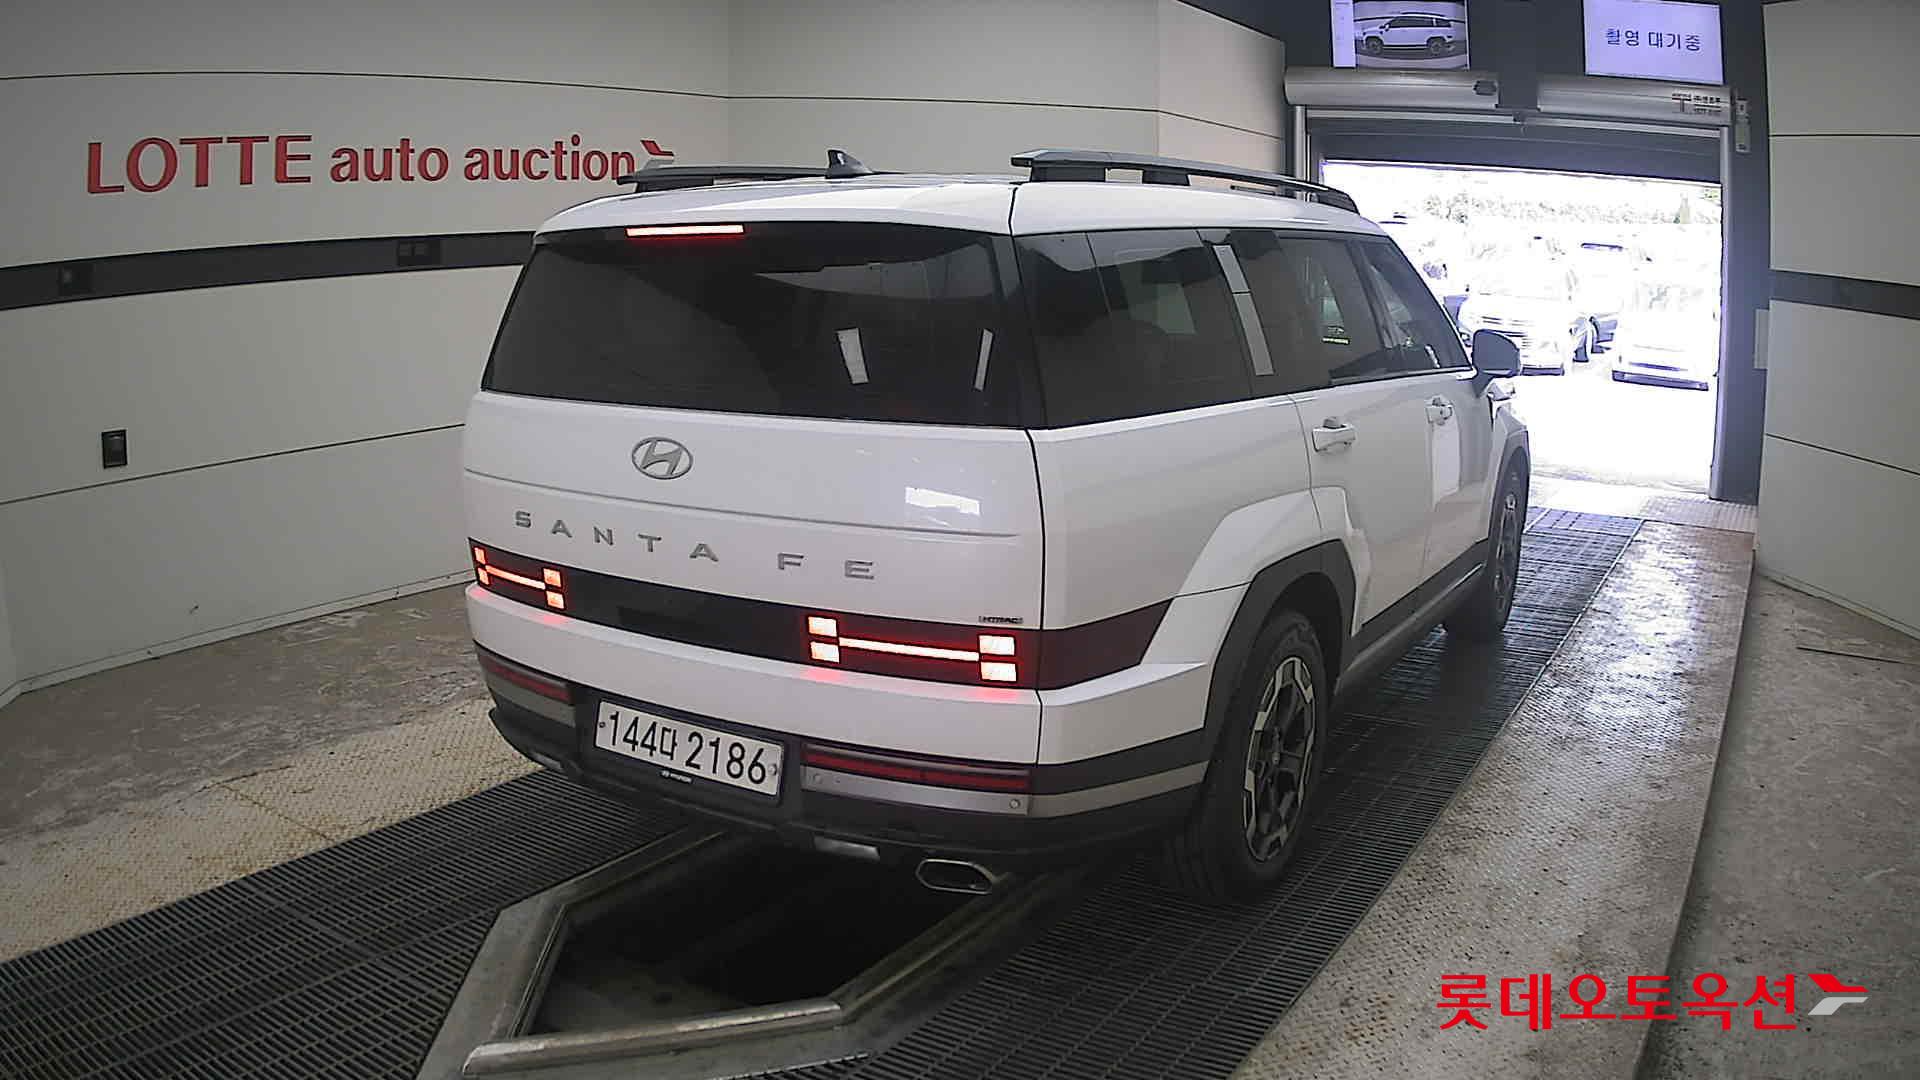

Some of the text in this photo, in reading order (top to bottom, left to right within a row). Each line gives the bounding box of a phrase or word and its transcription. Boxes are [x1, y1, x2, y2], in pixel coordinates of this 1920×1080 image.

[1647, 30, 1700, 52] 대기중
[87, 133, 637, 194] LOTTE auto auction
[514, 510, 876, 581] SANTA FE
[609, 711, 767, 785] 144다 2186
